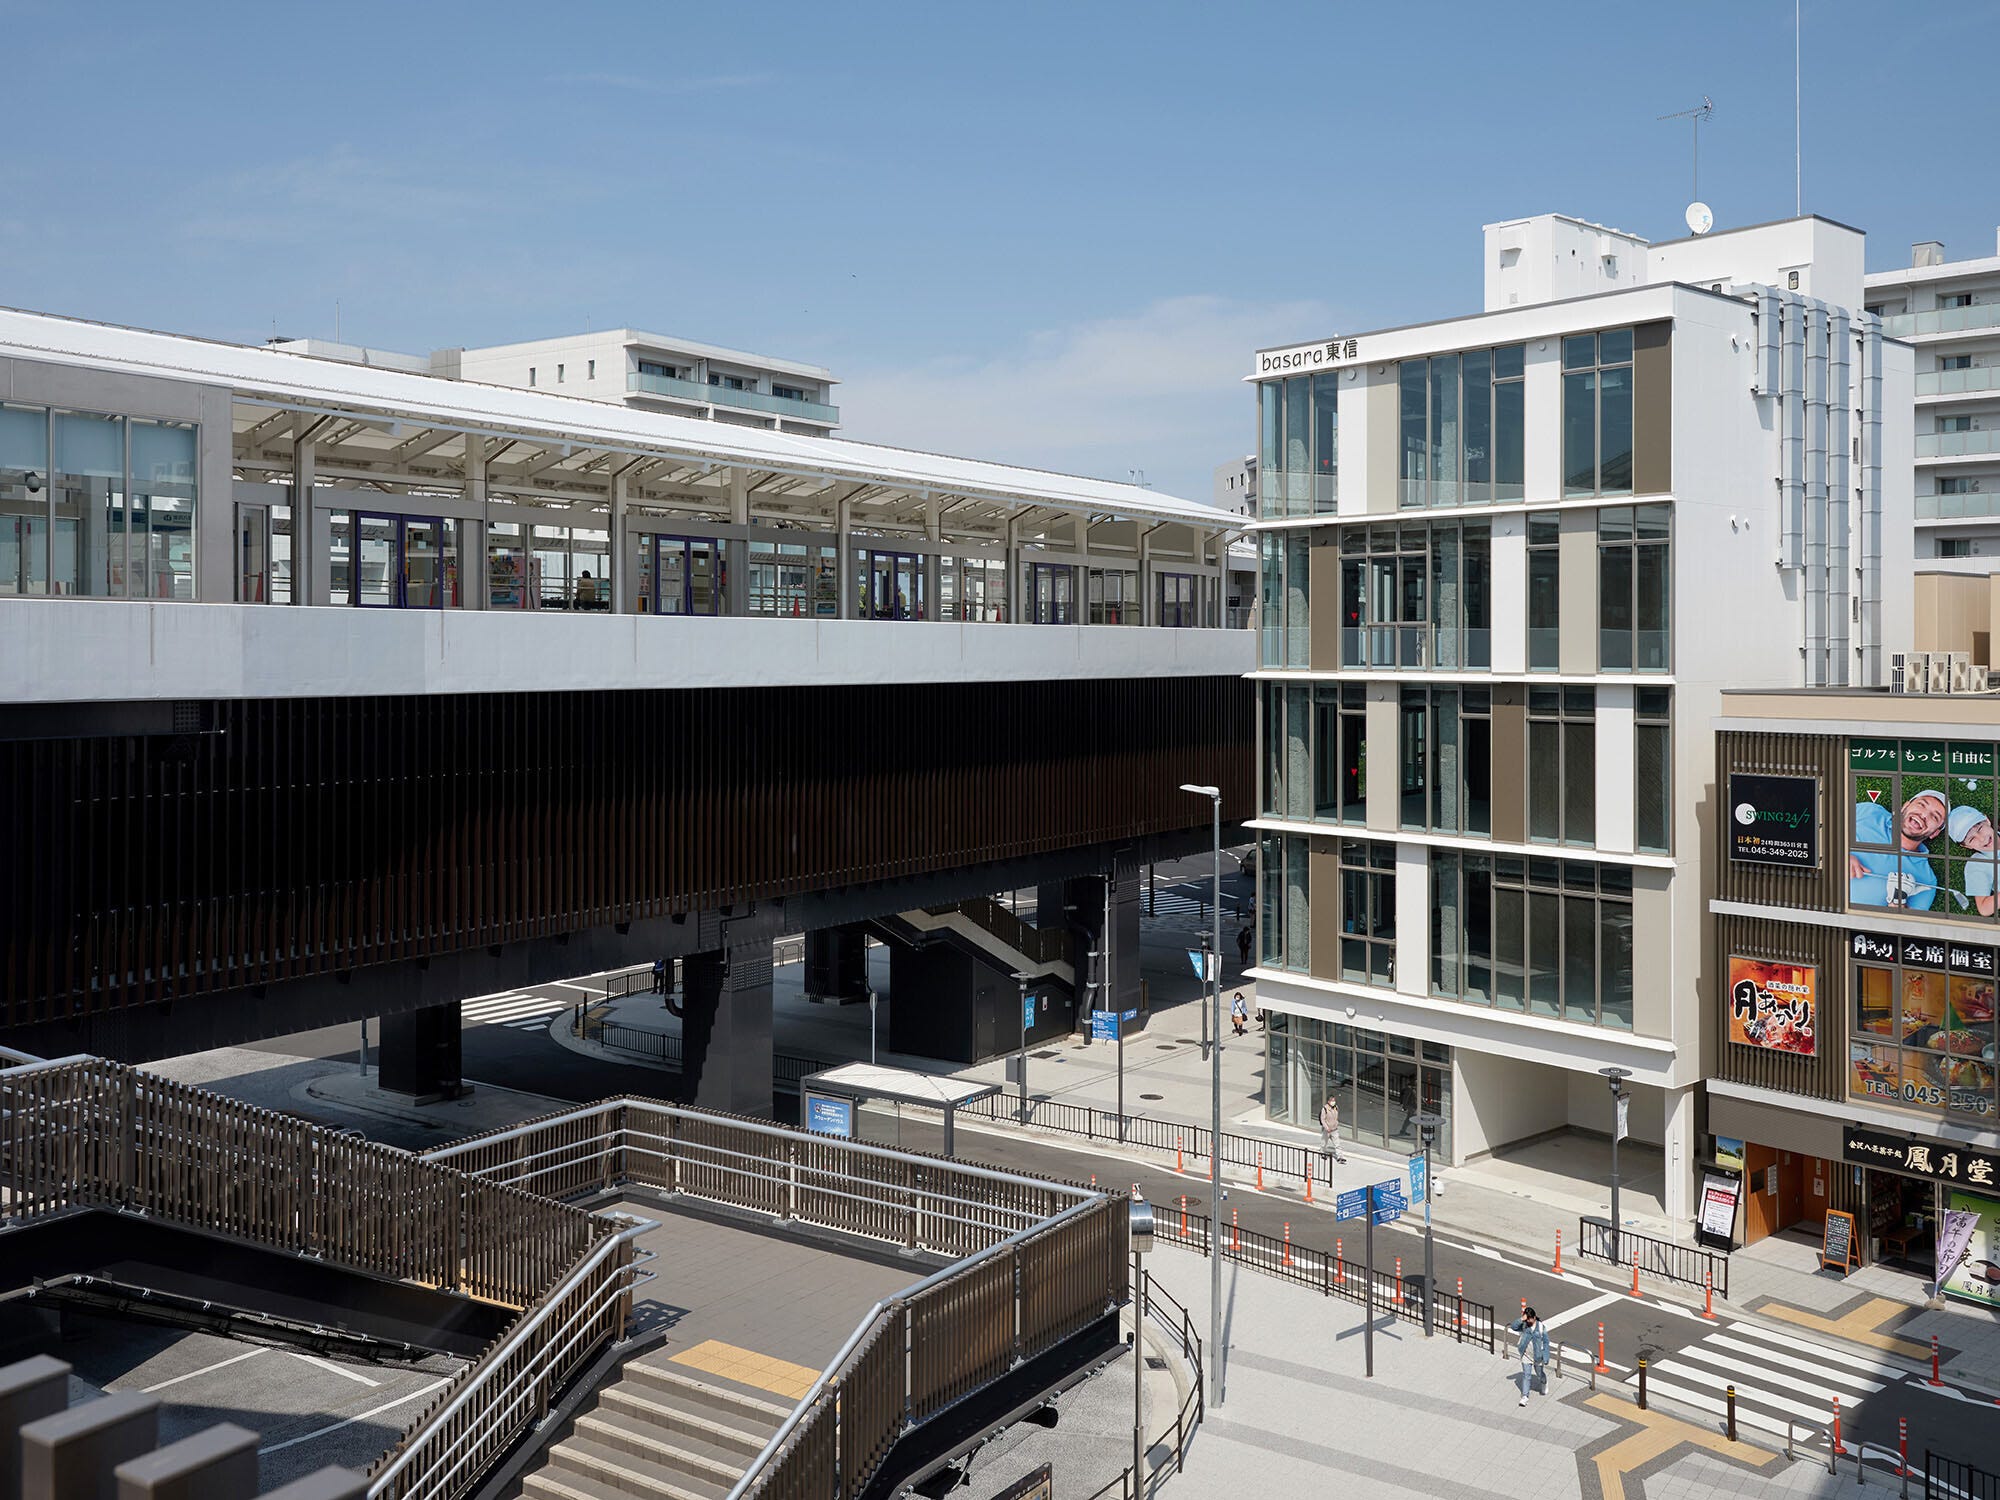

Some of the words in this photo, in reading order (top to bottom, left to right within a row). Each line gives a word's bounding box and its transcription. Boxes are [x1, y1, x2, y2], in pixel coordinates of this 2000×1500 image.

[1851, 747, 1896, 759] ゴルフを
[1905, 749, 1942, 762] もっと
[1952, 750, 1992, 764] 自由に
[1751, 846, 1809, 859] 045-349-2025
[1734, 980, 1809, 1028] 月あかり
[1904, 1146, 1994, 1185] 鳳月堂
